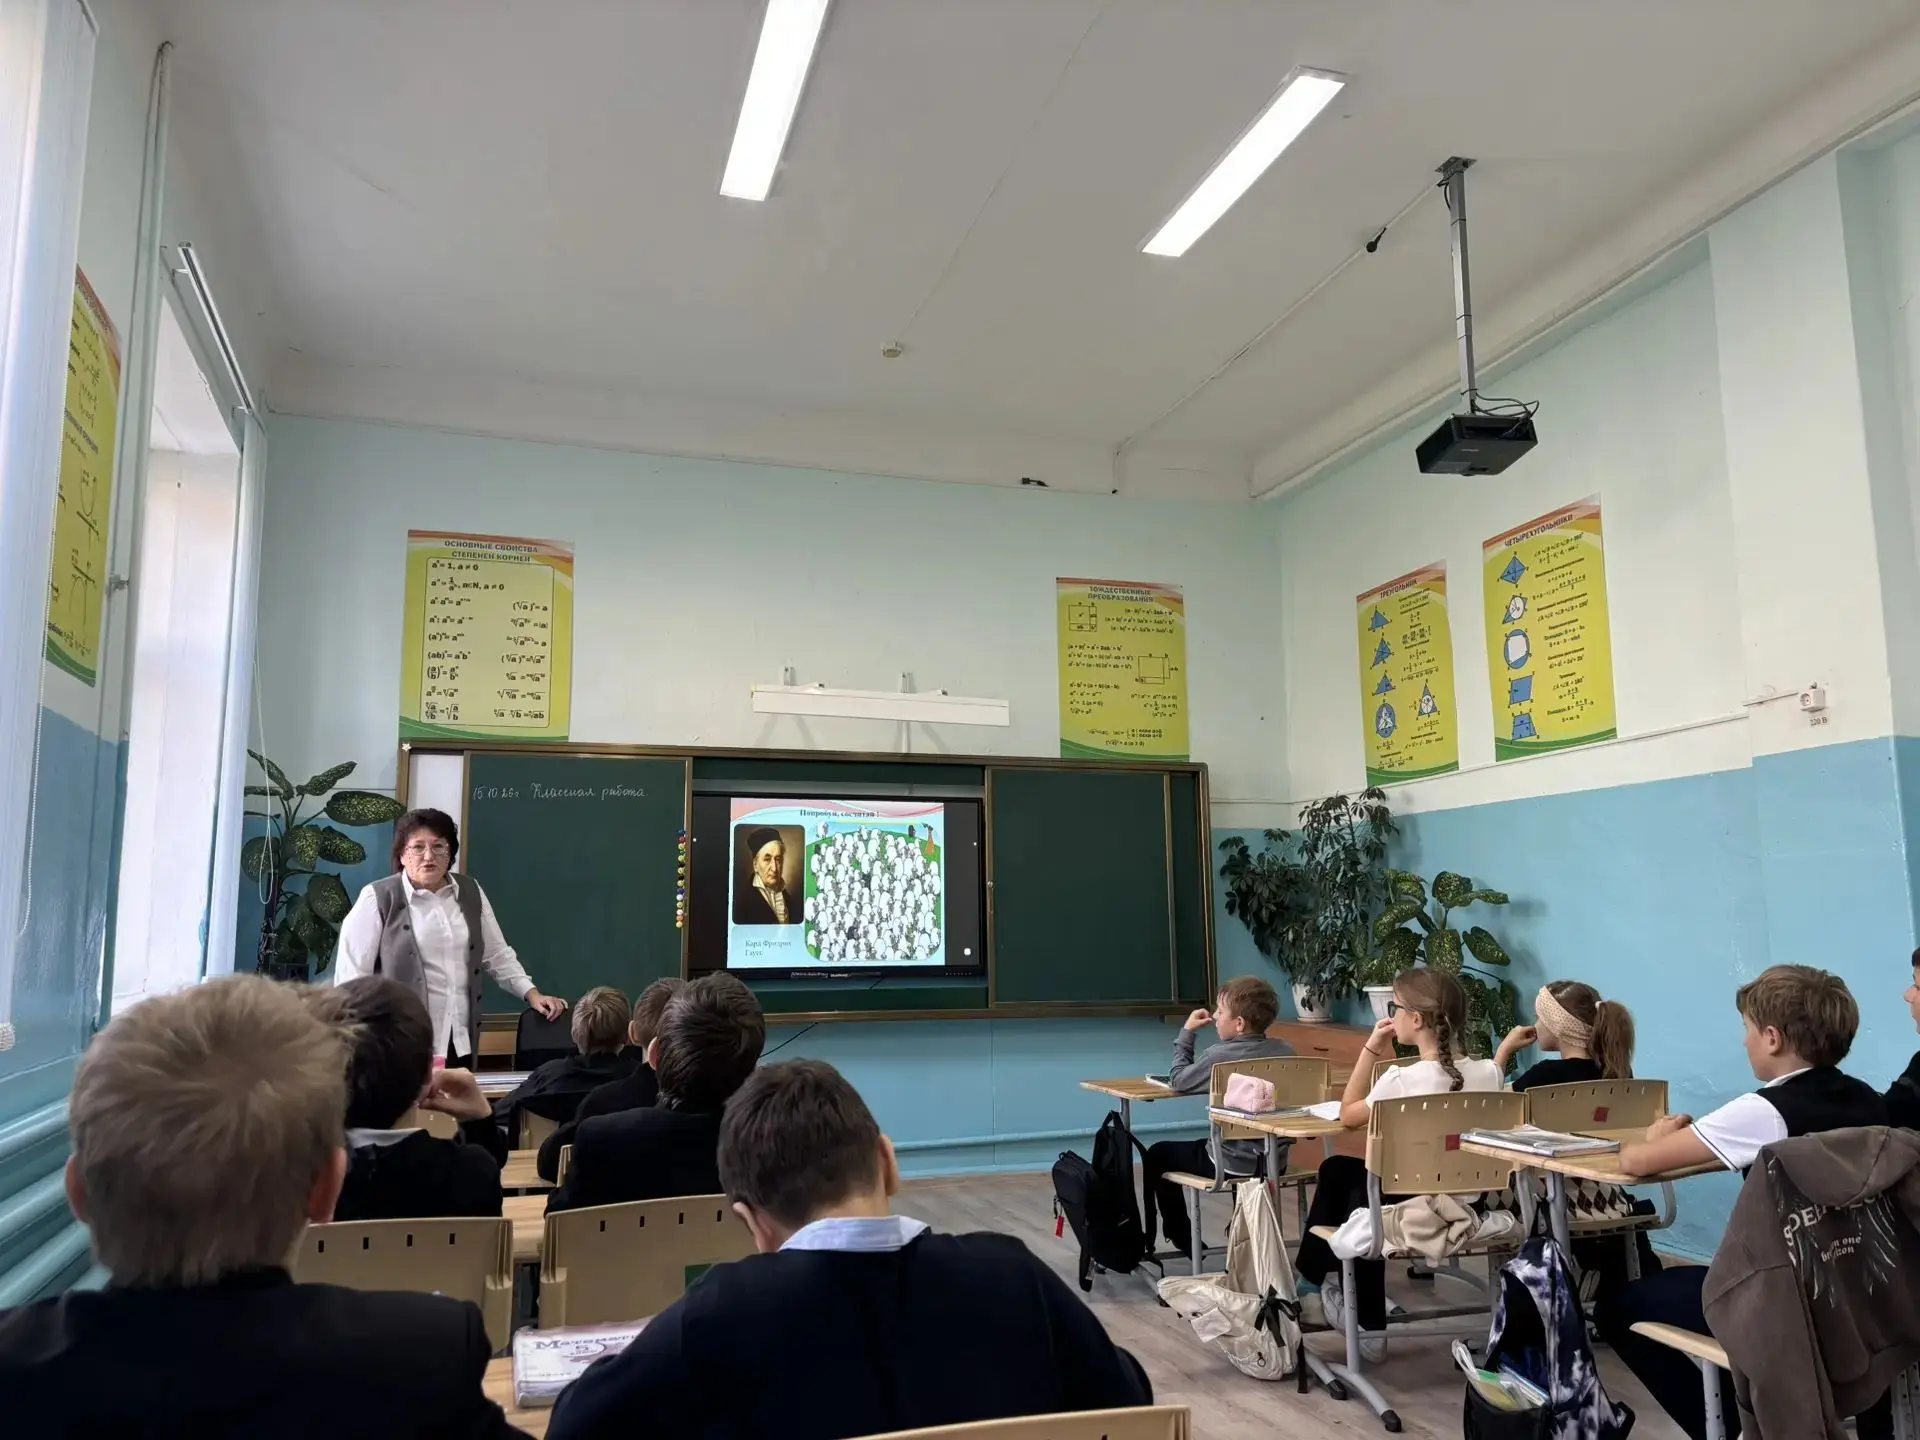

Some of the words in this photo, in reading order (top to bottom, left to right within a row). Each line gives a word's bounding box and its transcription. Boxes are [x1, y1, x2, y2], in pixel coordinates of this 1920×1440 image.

[444, 541, 493, 550] ОСНОВНЫЕ
[495, 543, 538, 552] СВОЙСТВА
[452, 550, 494, 559] СТЕПЕНЕЙ
[496, 554, 530, 562] КОРНЕЙ
[1089, 586, 1152, 595] ТОЖДЕСТВЕННЫЕ
[1088, 593, 1154, 602] ПРЕОБРАЗОВАНИЯ
[531, 782, 595, 799] Классная
